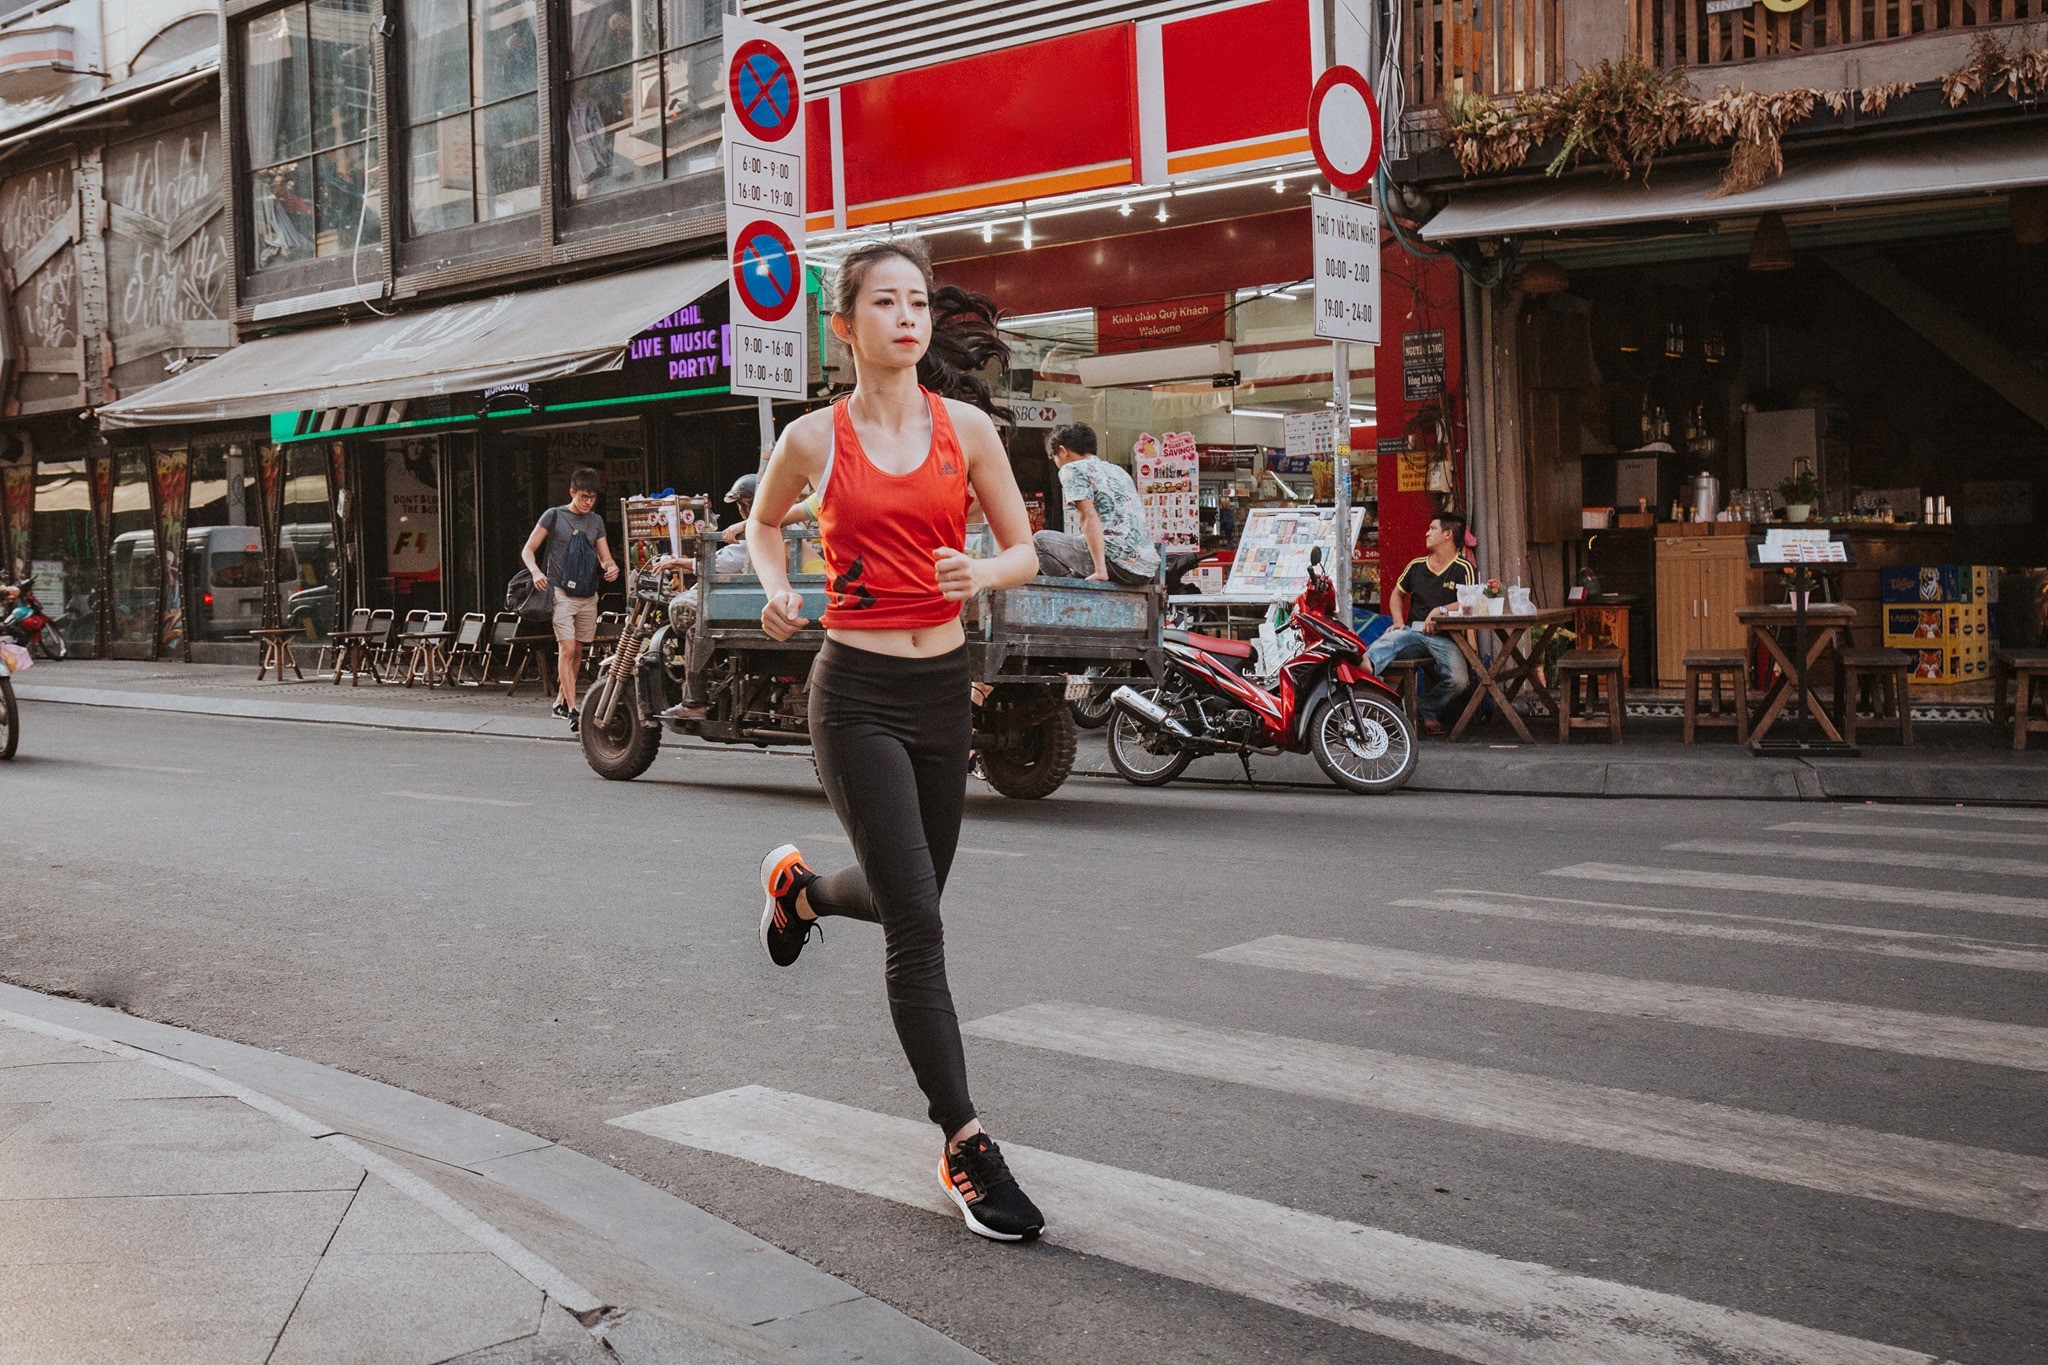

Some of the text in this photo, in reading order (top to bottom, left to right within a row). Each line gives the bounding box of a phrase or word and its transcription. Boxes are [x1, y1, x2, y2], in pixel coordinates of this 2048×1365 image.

[743, 156, 761, 173] 6:00
[771, 162, 788, 179] 9:00
[738, 183, 760, 201] 16:00
[771, 189, 792, 207] 19:00
[1316, 212, 1377, 248] THỨ 7 VÀ CHỦ NHẬT
[1325, 258, 1347, 279] 00:00
[1354, 263, 1370, 283] 2:00
[1179, 305, 1209, 317] Khách
[1324, 298, 1344, 318] 19:00
[1352, 303, 1372, 322] 24:00
[1139, 324, 1181, 336] Welcome
[631, 337, 662, 360] LIVE
[670, 329, 717, 354] MUSIC
[744, 336, 762, 354] 9:00
[772, 340, 794, 357] 16:00
[669, 355, 717, 380] PARTY
[744, 363, 766, 380] 19:00
[775, 367, 792, 383] 6:00
[1163, 444, 1195, 457] SAVINGS
